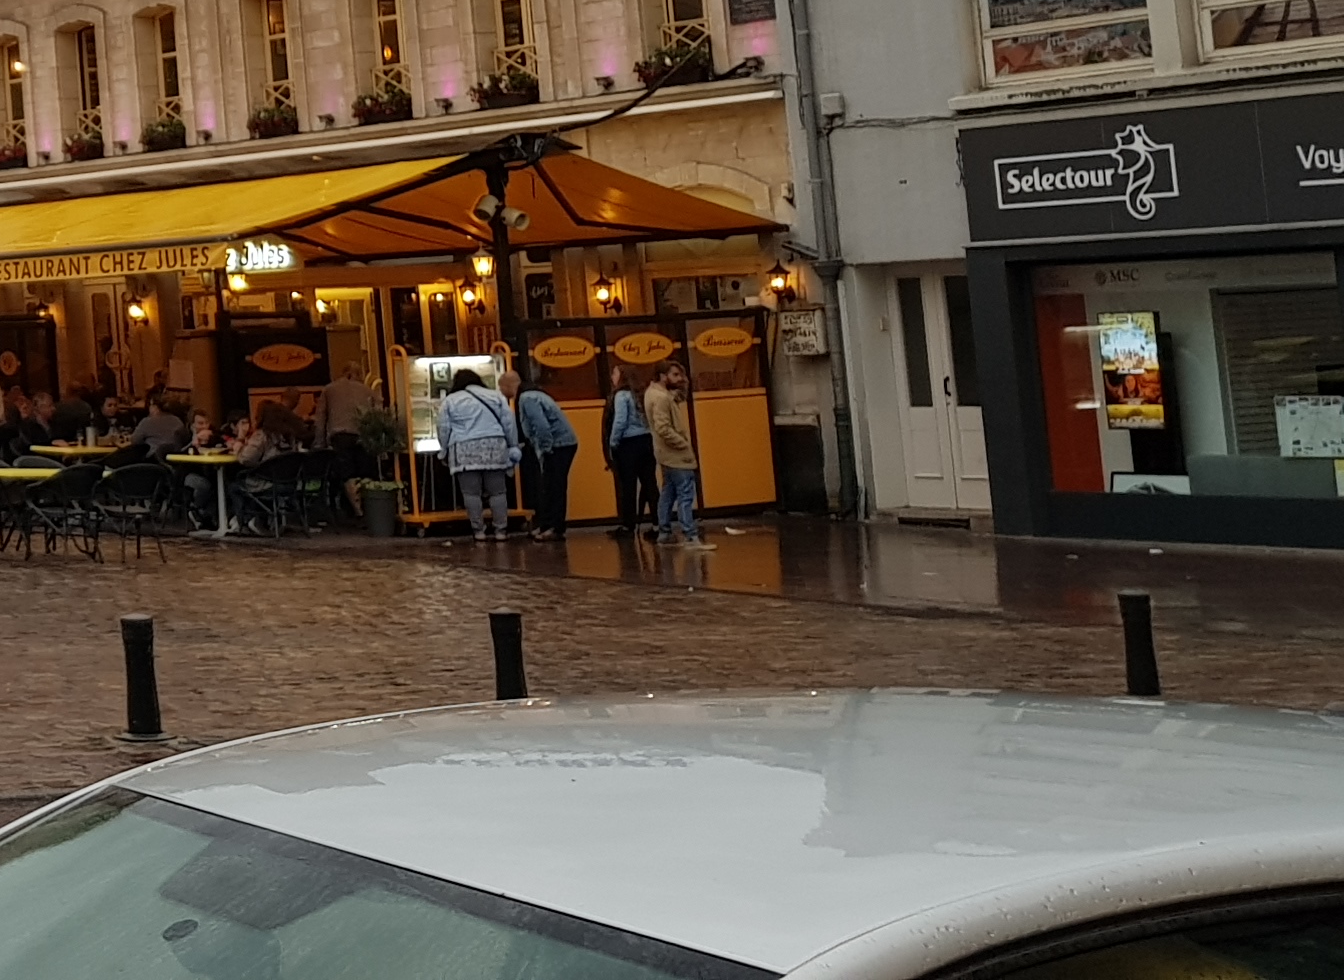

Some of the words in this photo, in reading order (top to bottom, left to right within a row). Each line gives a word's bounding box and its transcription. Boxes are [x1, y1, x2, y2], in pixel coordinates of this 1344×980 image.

[1007, 167, 1116, 194] Selectour
[99, 250, 147, 273] CHEZ
[156, 246, 210, 269] JULES
[240, 240, 291, 270] Jules
[1110, 268, 1141, 284] MSC
